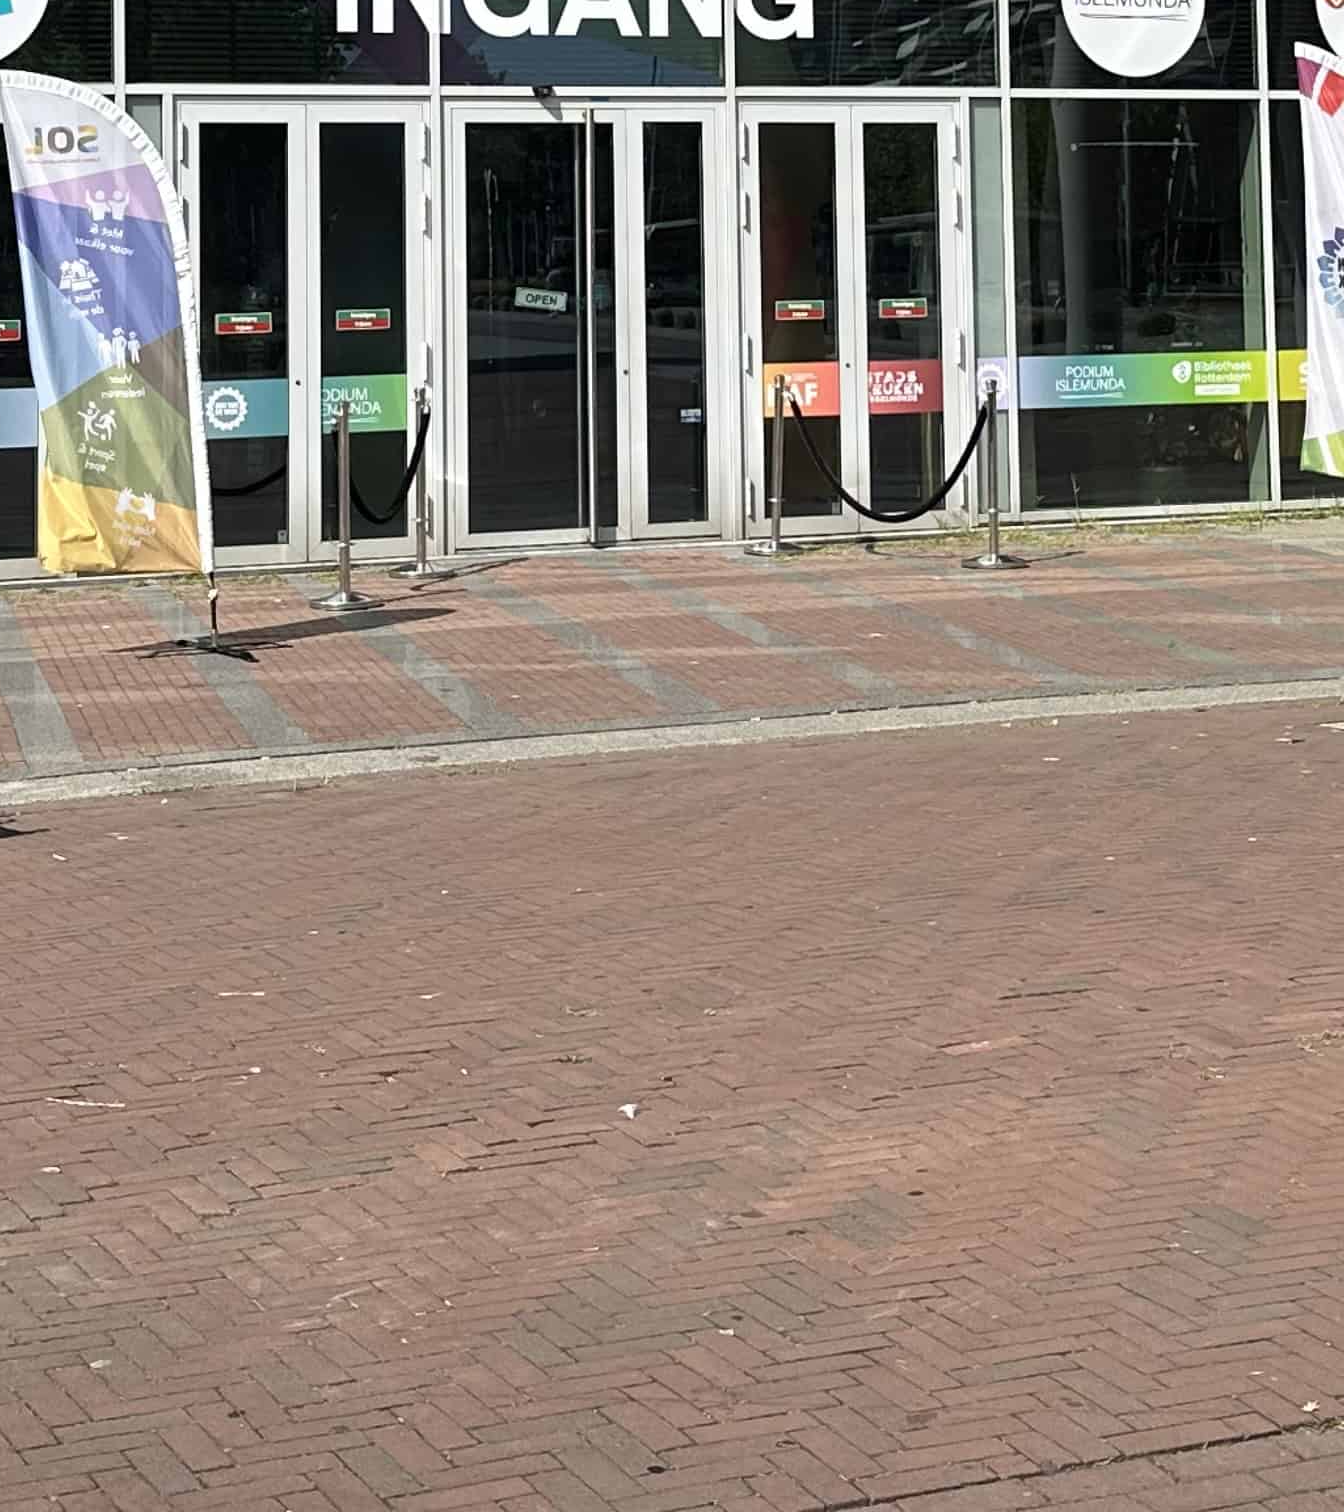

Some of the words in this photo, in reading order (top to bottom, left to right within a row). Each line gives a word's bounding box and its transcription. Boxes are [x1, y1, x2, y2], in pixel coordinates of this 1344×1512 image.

[525, 292, 558, 306] OPEN
[1065, 365, 1114, 379] PODIUM
[871, 382, 924, 396] EUKEN
[1055, 377, 1126, 392] ISLEMUNDA
[322, 388, 369, 403] ODIUM
